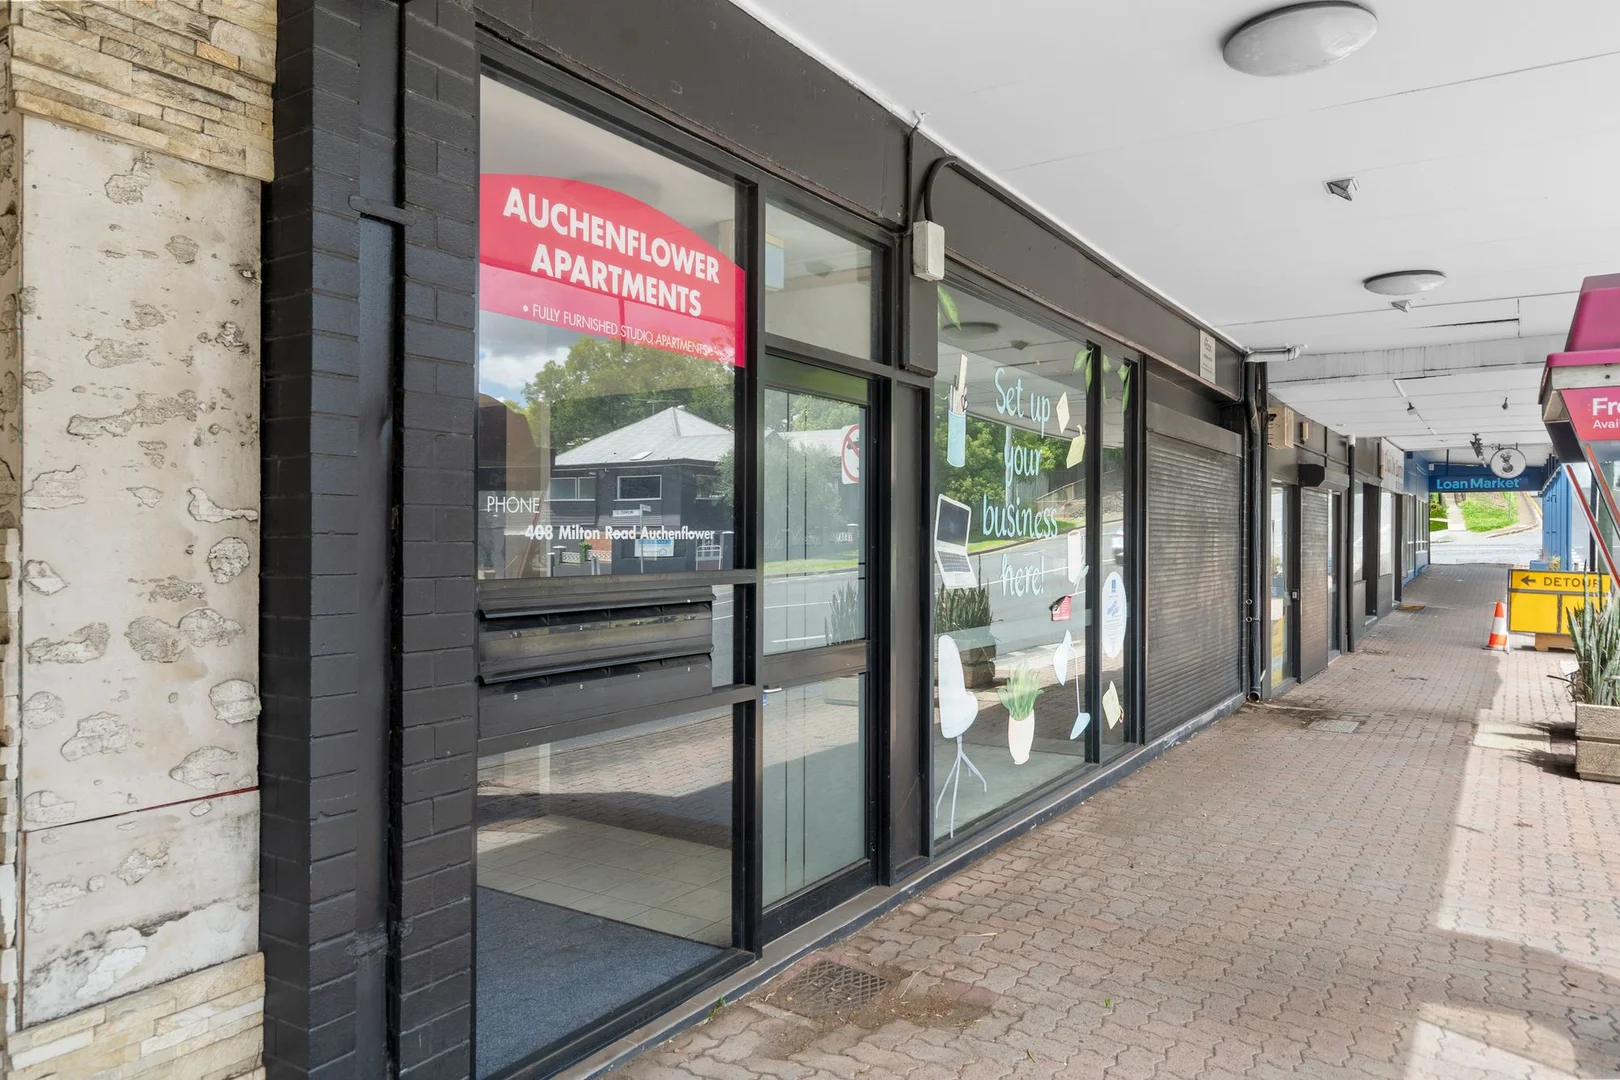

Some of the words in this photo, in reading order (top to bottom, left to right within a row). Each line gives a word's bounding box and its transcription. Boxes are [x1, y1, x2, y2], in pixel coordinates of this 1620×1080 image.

[503, 187, 720, 284] AUCHENFLOWER
[530, 244, 702, 317] APARTMENTS
[532, 304, 561, 321] FULLY
[563, 311, 618, 336] FURNISHED
[656, 333, 708, 356] APARTMENTS
[995, 367, 1025, 418] Set
[1030, 392, 1051, 438] up
[1592, 397, 1620, 416] Fr
[1004, 441, 1042, 487] your
[1436, 479, 1468, 490] Loan
[1470, 478, 1520, 489] Market
[487, 495, 540, 514] PHONE
[982, 494, 1058, 539] business
[524, 524, 554, 541] 408
[558, 525, 601, 540] Milton
[604, 525, 636, 540] Road
[640, 525, 716, 541] Auchenflower
[1001, 553, 1045, 597] here!
